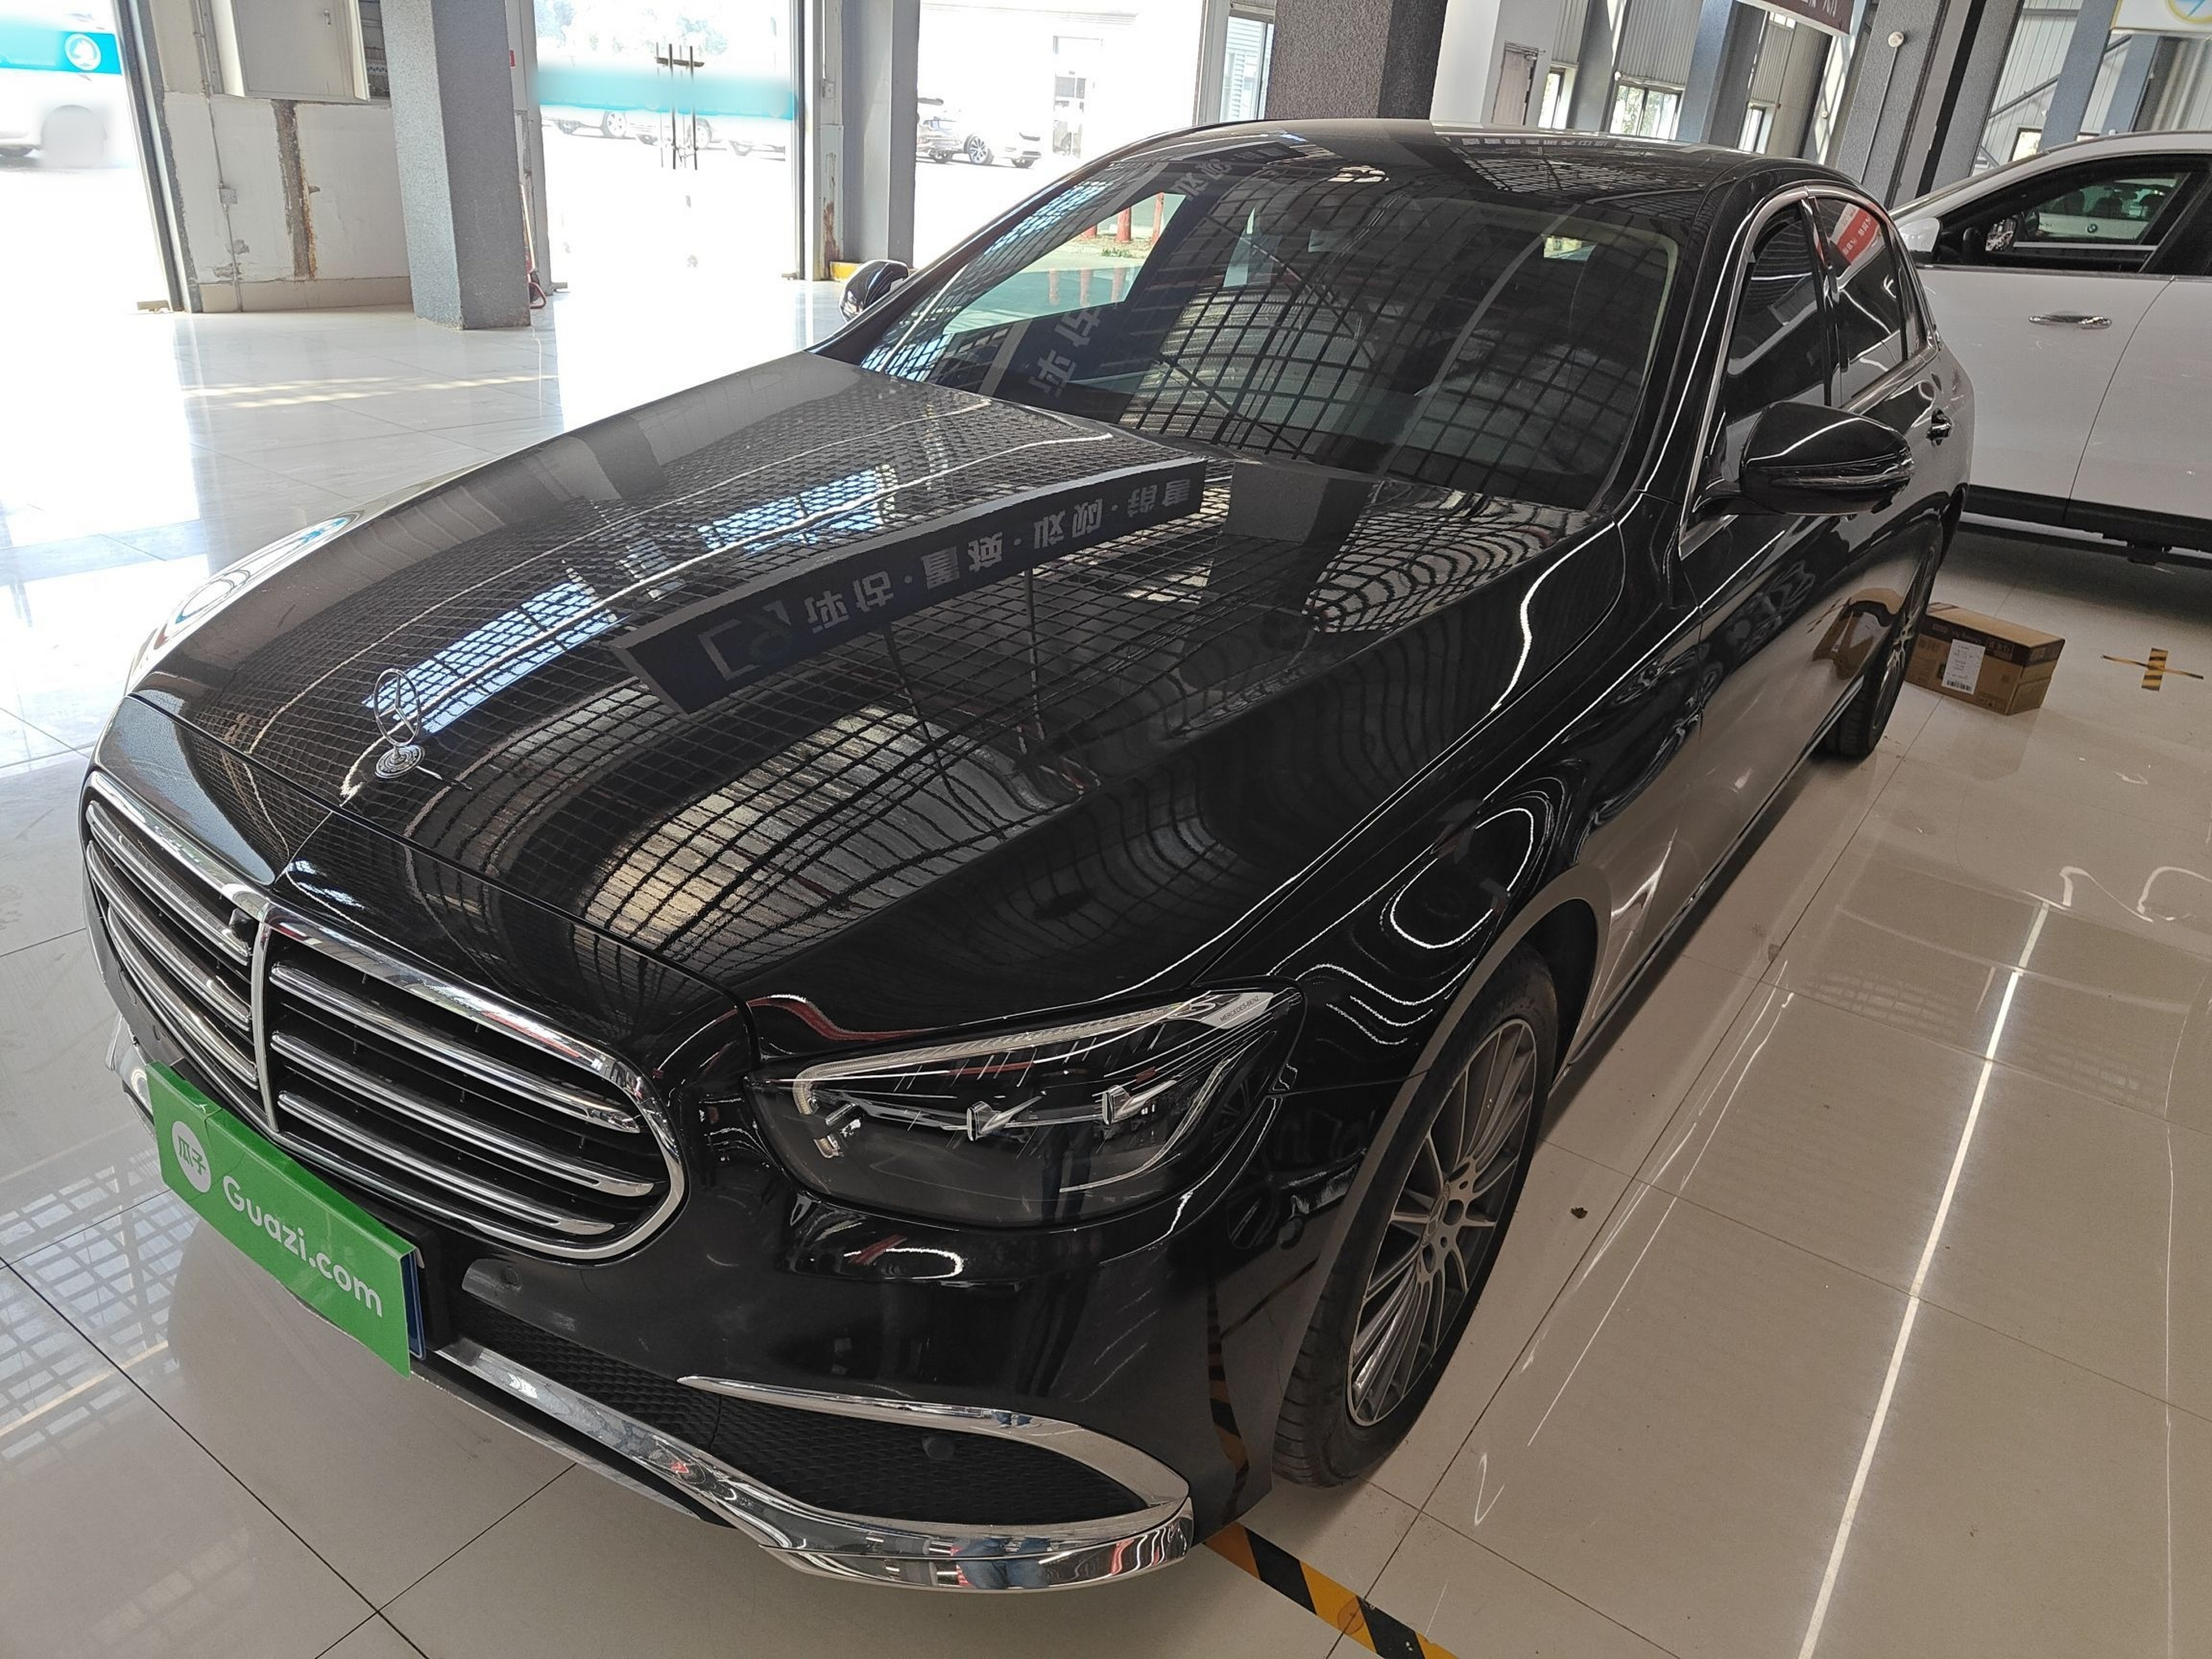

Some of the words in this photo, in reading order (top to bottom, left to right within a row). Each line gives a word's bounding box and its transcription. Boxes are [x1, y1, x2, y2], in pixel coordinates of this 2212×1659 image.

[1219, 995, 1260, 1022] MERCEDES-BENZ
[177, 1135, 206, 1176] 瓜子
[223, 1175, 383, 1317] Guazi.com
